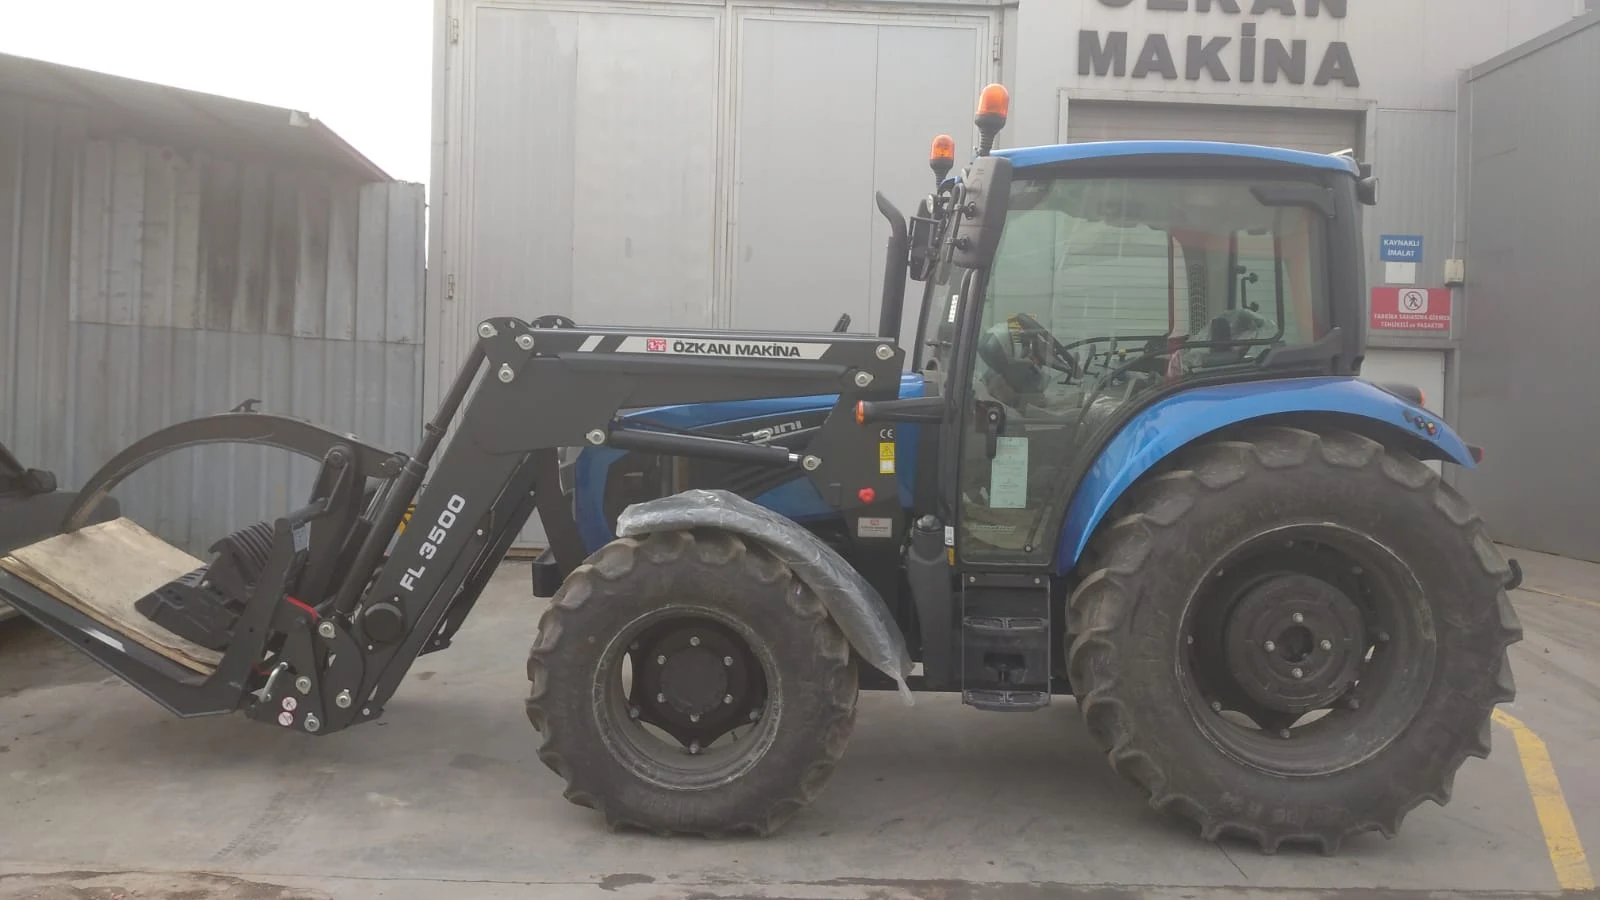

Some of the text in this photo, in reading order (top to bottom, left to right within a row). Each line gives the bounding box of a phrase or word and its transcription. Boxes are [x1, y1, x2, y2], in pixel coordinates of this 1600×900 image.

[1078, 22, 1360, 88] MAKİNA
[1387, 247, 1415, 257] İMALAT
[673, 339, 731, 355] ÖZKAN
[735, 342, 801, 357] MAKİNA
[879, 428, 894, 439] CE
[399, 494, 466, 592] FL 3500
